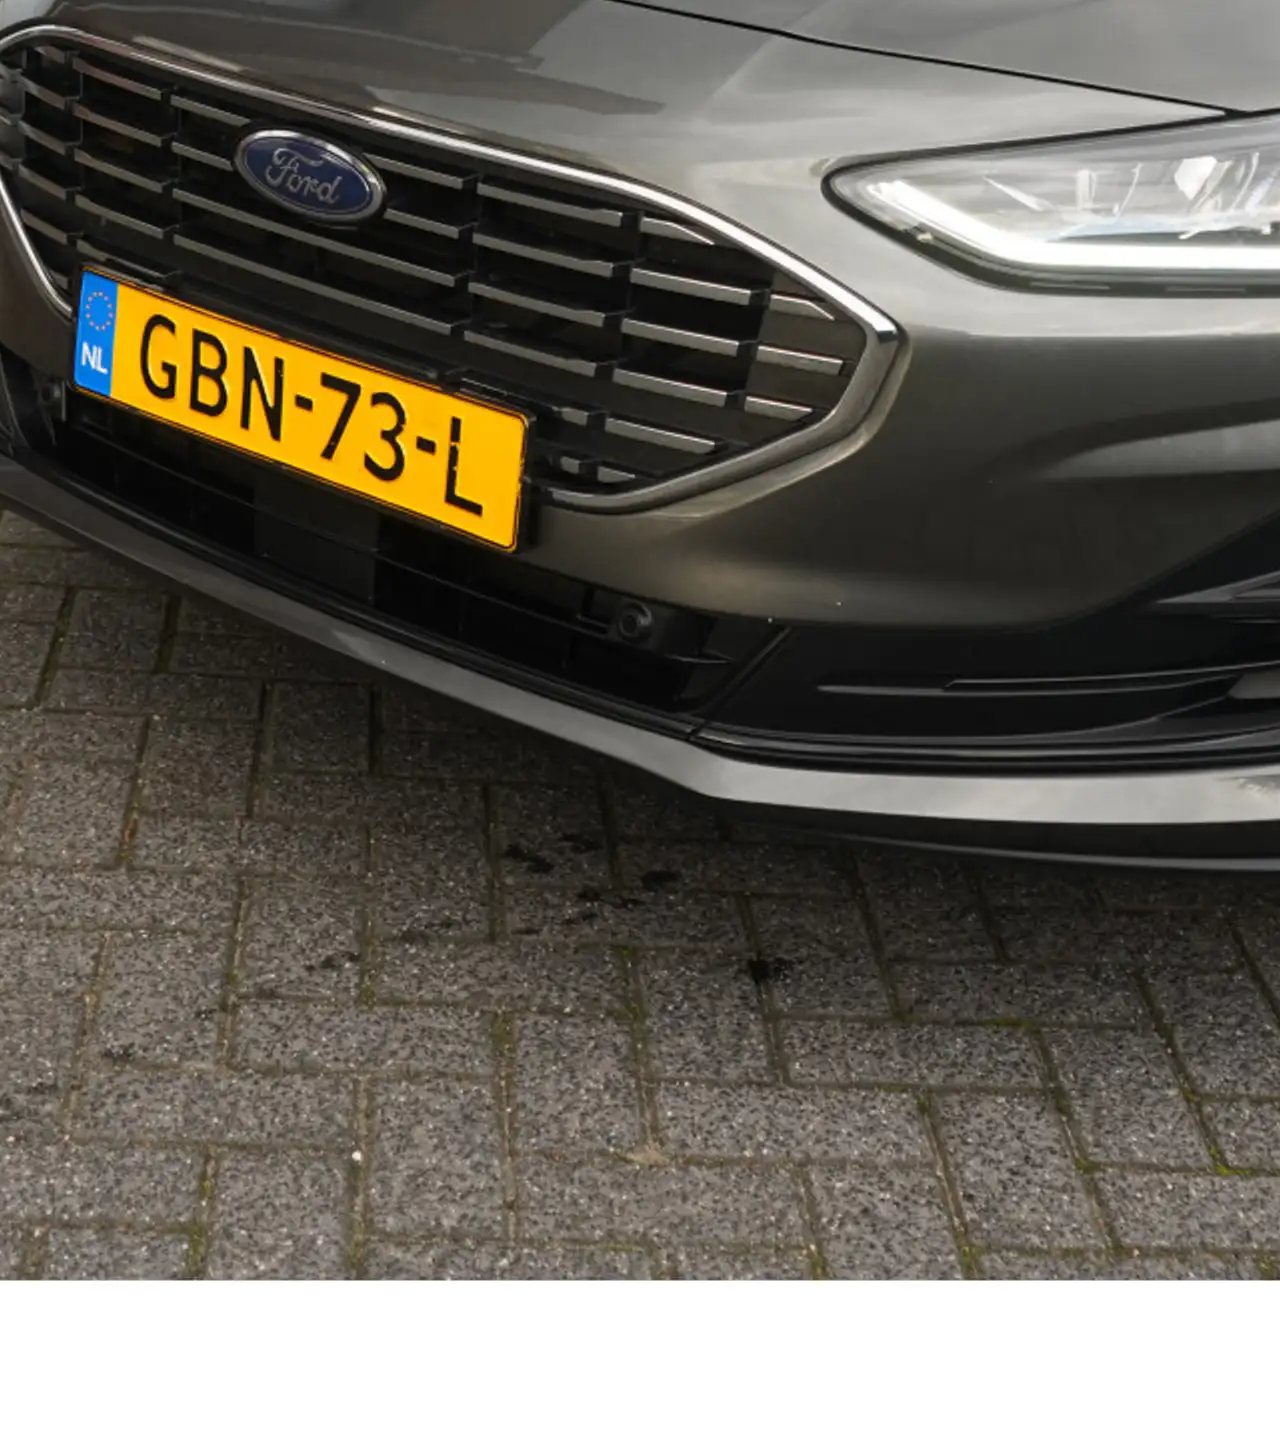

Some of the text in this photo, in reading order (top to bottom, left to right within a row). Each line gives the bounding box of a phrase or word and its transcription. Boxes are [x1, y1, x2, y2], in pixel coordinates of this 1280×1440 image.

[264, 147, 342, 205] Ford
[81, 341, 109, 376] NL
[139, 313, 484, 517] GBN-73-L
